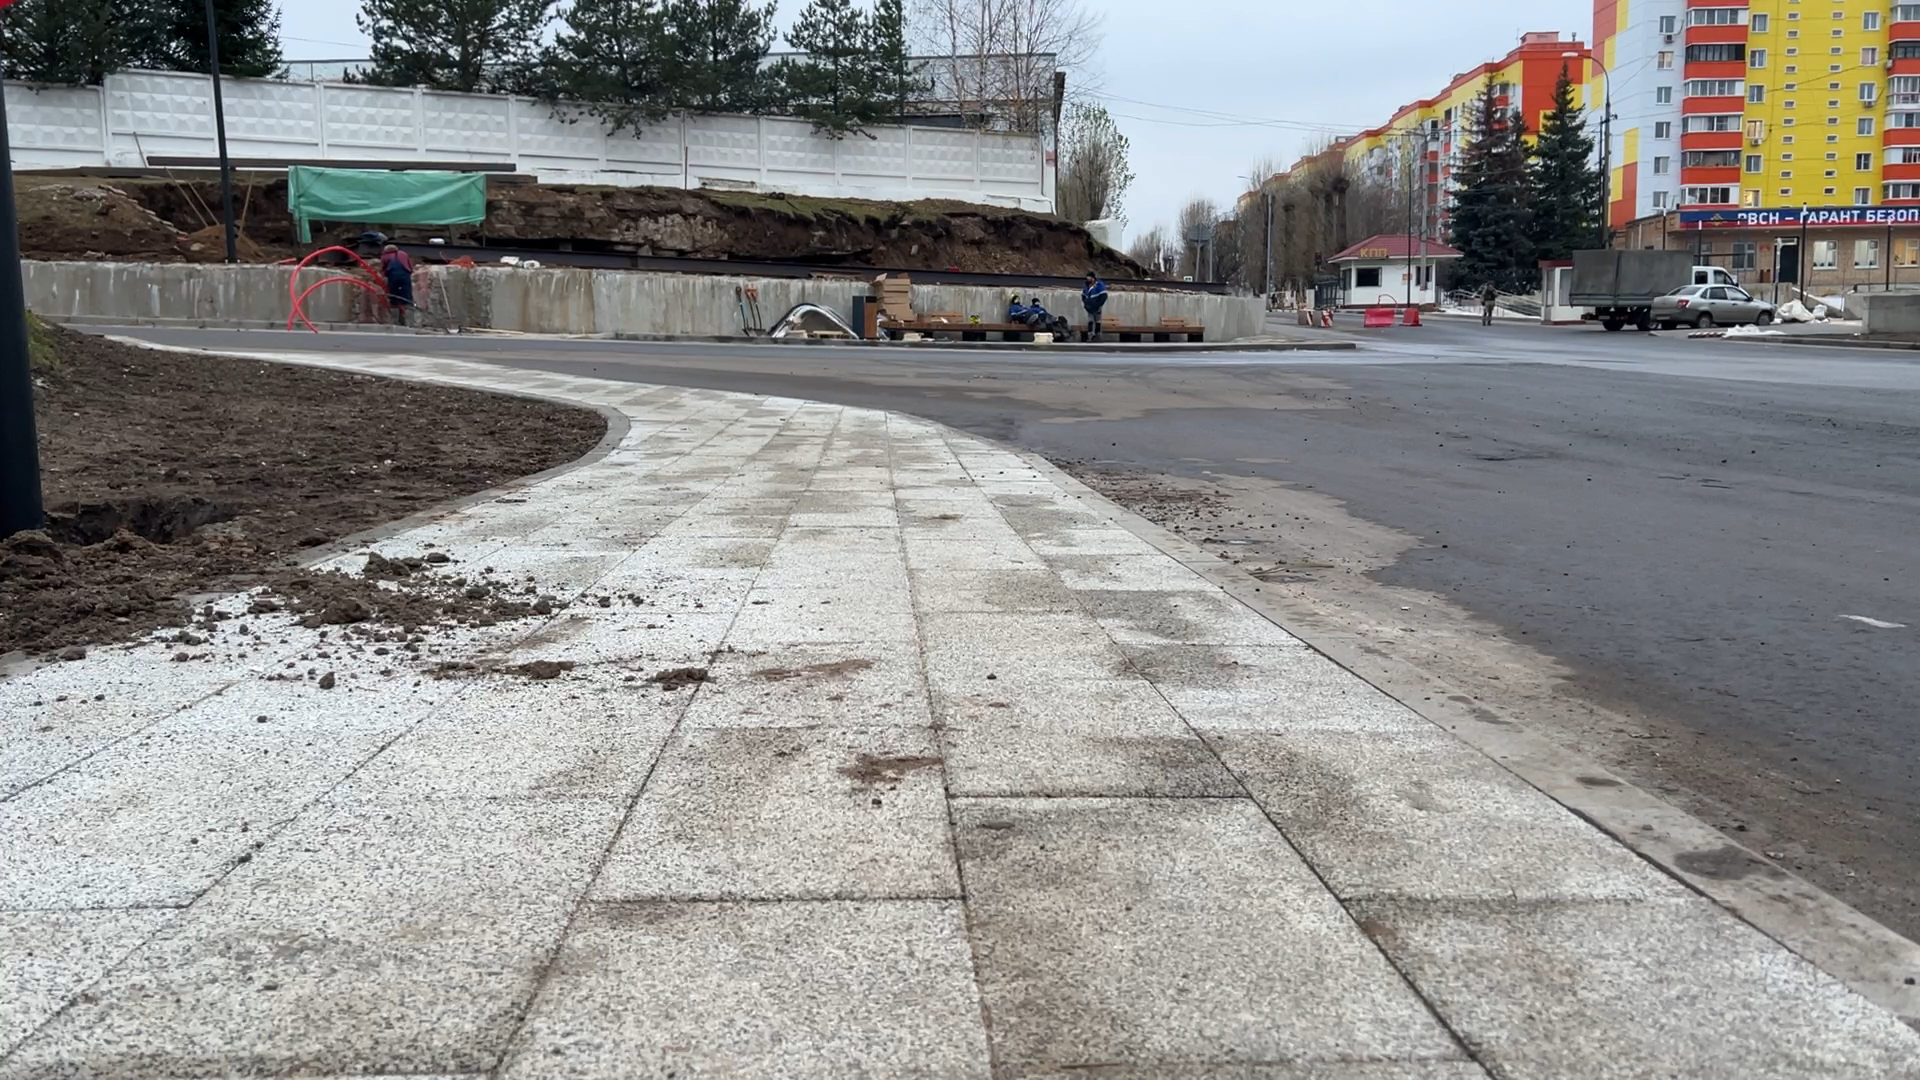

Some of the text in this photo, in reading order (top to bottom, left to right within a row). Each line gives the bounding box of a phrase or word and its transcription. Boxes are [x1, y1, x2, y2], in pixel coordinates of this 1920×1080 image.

[1800, 210, 1860, 224] ГАРАНТ
[1866, 209, 1918, 223] БЕЗОП
[1360, 247, 1388, 258] КПП
